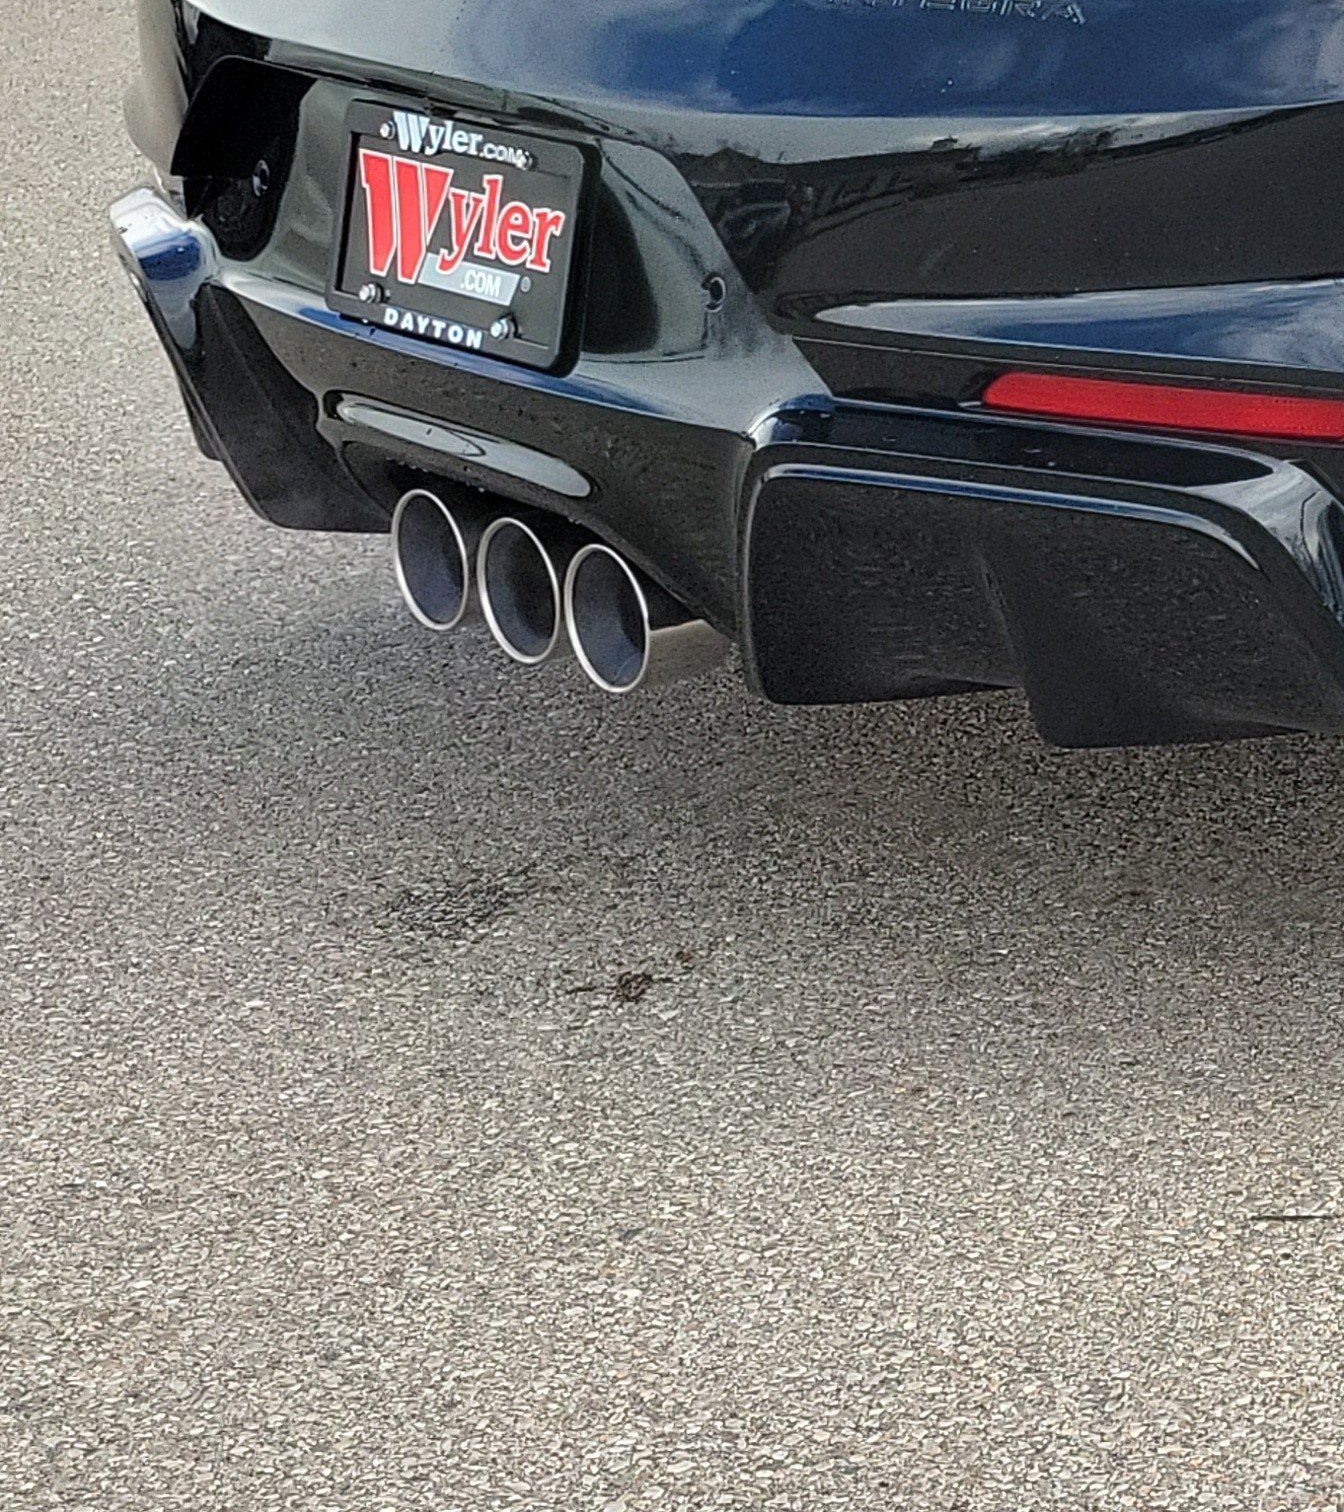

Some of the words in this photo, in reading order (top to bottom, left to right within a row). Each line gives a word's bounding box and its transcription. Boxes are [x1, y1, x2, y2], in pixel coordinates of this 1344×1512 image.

[359, 148, 565, 284] Wyler
[460, 269, 501, 298] .COM
[384, 307, 482, 349] DAYTON
